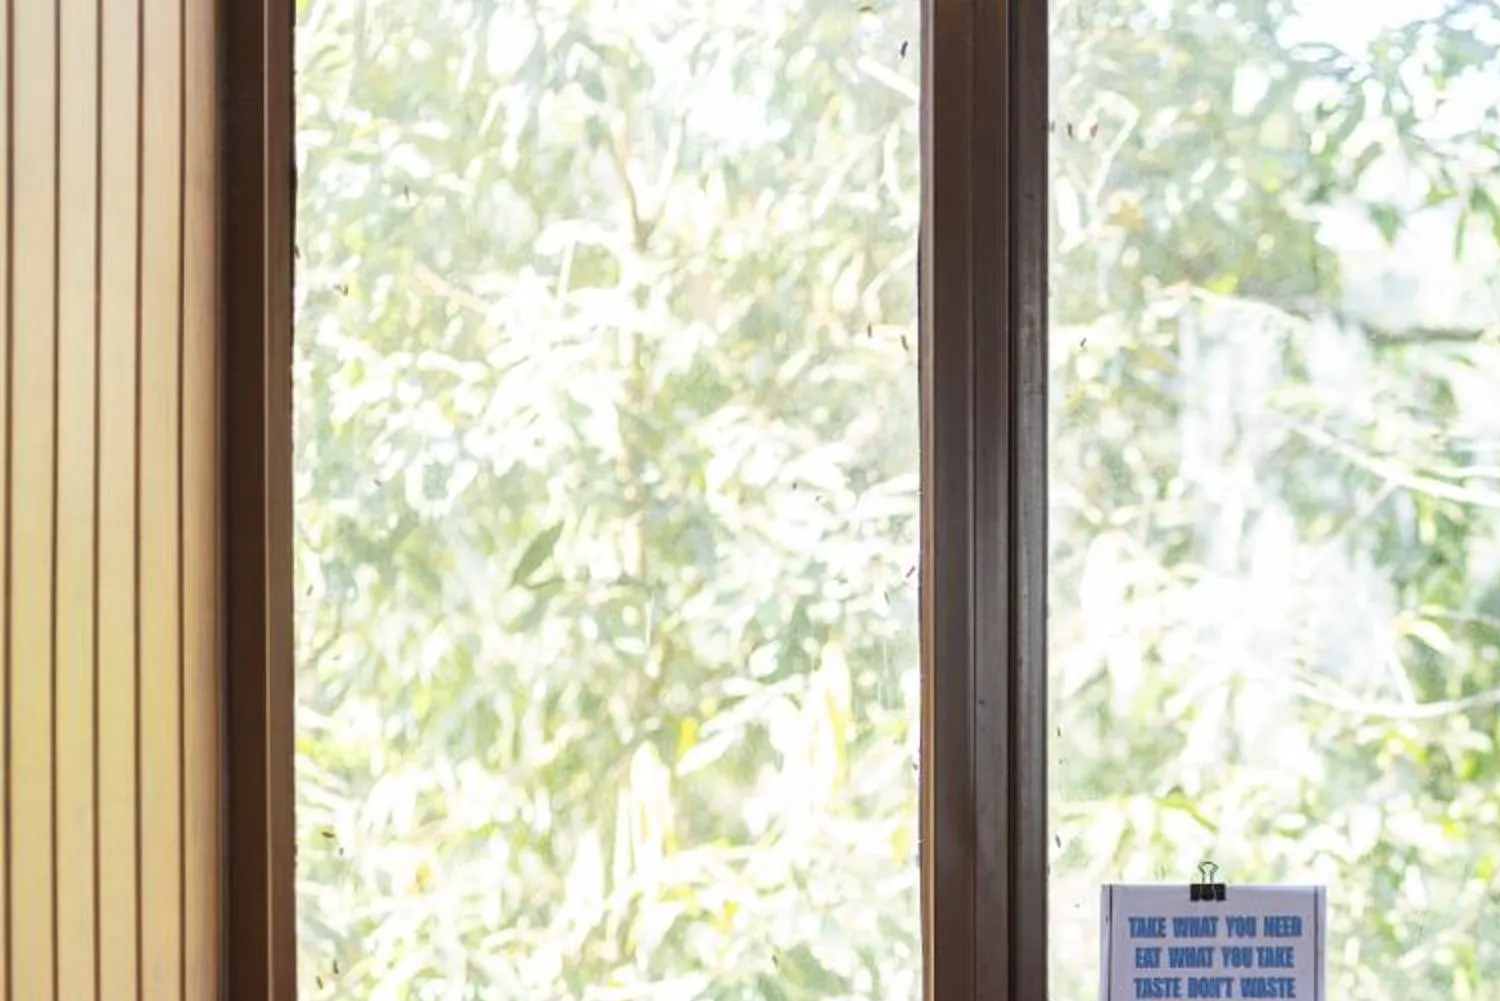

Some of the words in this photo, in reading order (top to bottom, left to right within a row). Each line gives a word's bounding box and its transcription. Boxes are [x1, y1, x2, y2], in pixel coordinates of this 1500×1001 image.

[1128, 916, 1166, 938] TAKE
[1173, 916, 1218, 938] WHAT
[1226, 916, 1257, 938] YOU
[1264, 916, 1302, 937] NEED
[1135, 947, 1161, 968] EAT
[1168, 947, 1215, 968] WHAT
[1221, 947, 1253, 968] YOU
[1256, 947, 1294, 968] TAKE
[1134, 977, 1182, 999] TASTE
[1188, 977, 1234, 999] DON'T
[1240, 977, 1296, 999] WASTE
